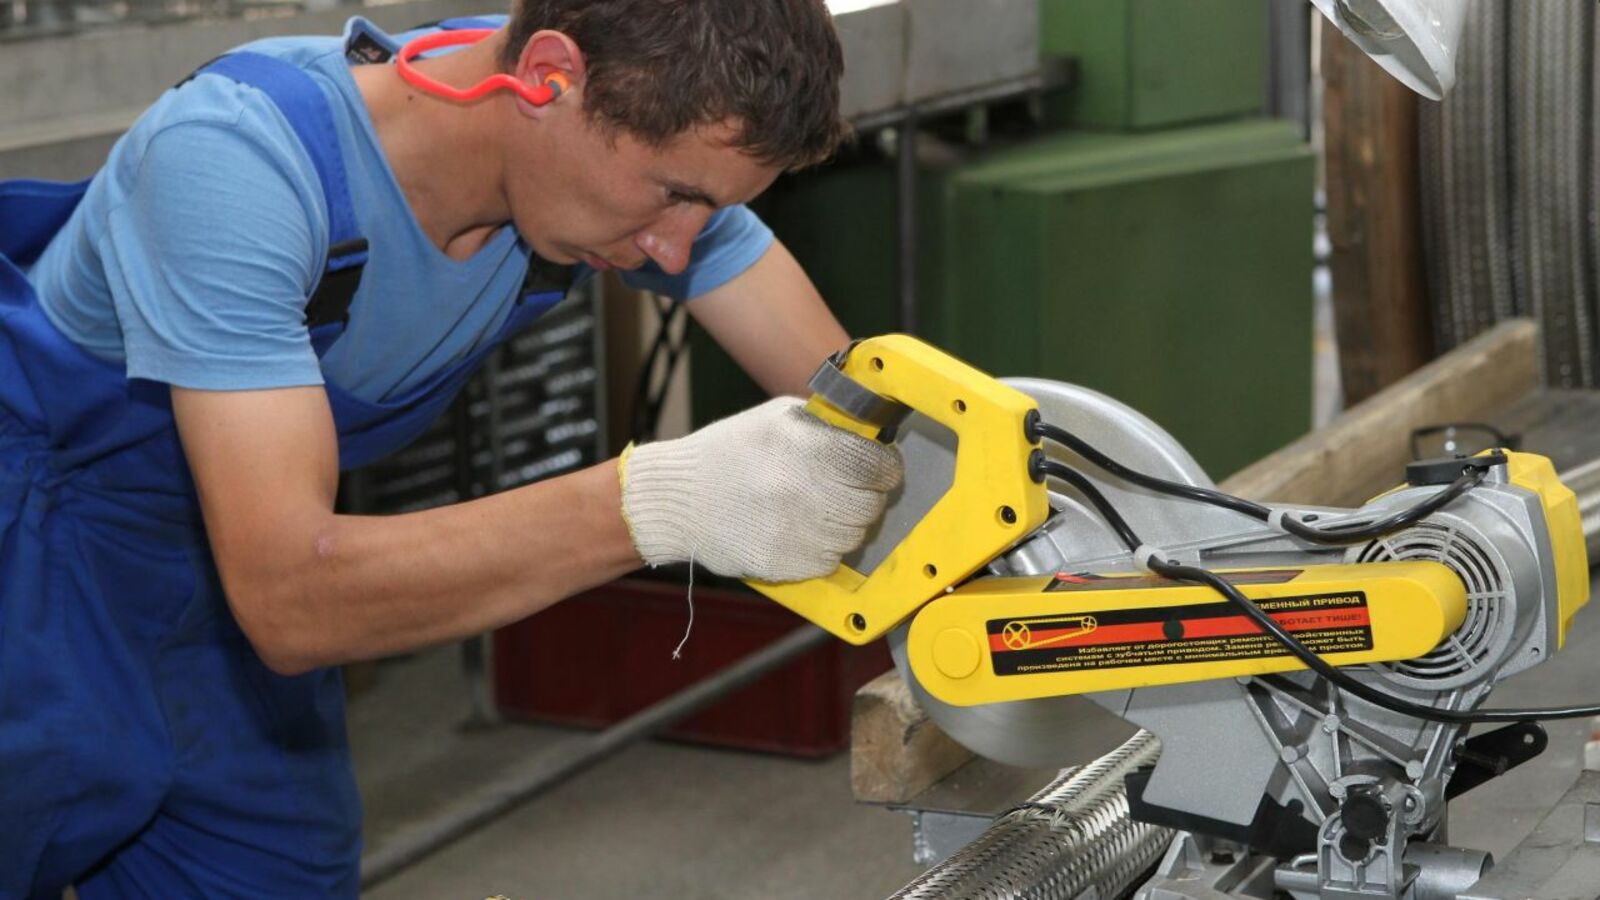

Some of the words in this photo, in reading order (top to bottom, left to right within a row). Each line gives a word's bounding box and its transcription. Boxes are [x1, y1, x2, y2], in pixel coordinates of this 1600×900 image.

[1254, 599, 1310, 610] ЕМЕННЫЙ
[1313, 596, 1360, 605] ПРИВОД
[1326, 613, 1361, 622] ТИШЕ!
[1078, 645, 1131, 654] Избавляет
[1147, 639, 1228, 651] дорогостоящих
[1230, 636, 1275, 645] ремонто
[1291, 629, 1364, 638] войственных
[1017, 662, 1081, 671] произведена
[1098, 658, 1142, 666] рабочем
[1184, 650, 1262, 660] минимальным
[1319, 643, 1366, 651] простоя.
[1055, 654, 1104, 662] системам
[1115, 650, 1165, 659] зубчатым
[1167, 646, 1222, 656] приводом.
[1224, 643, 1263, 651] Замена
